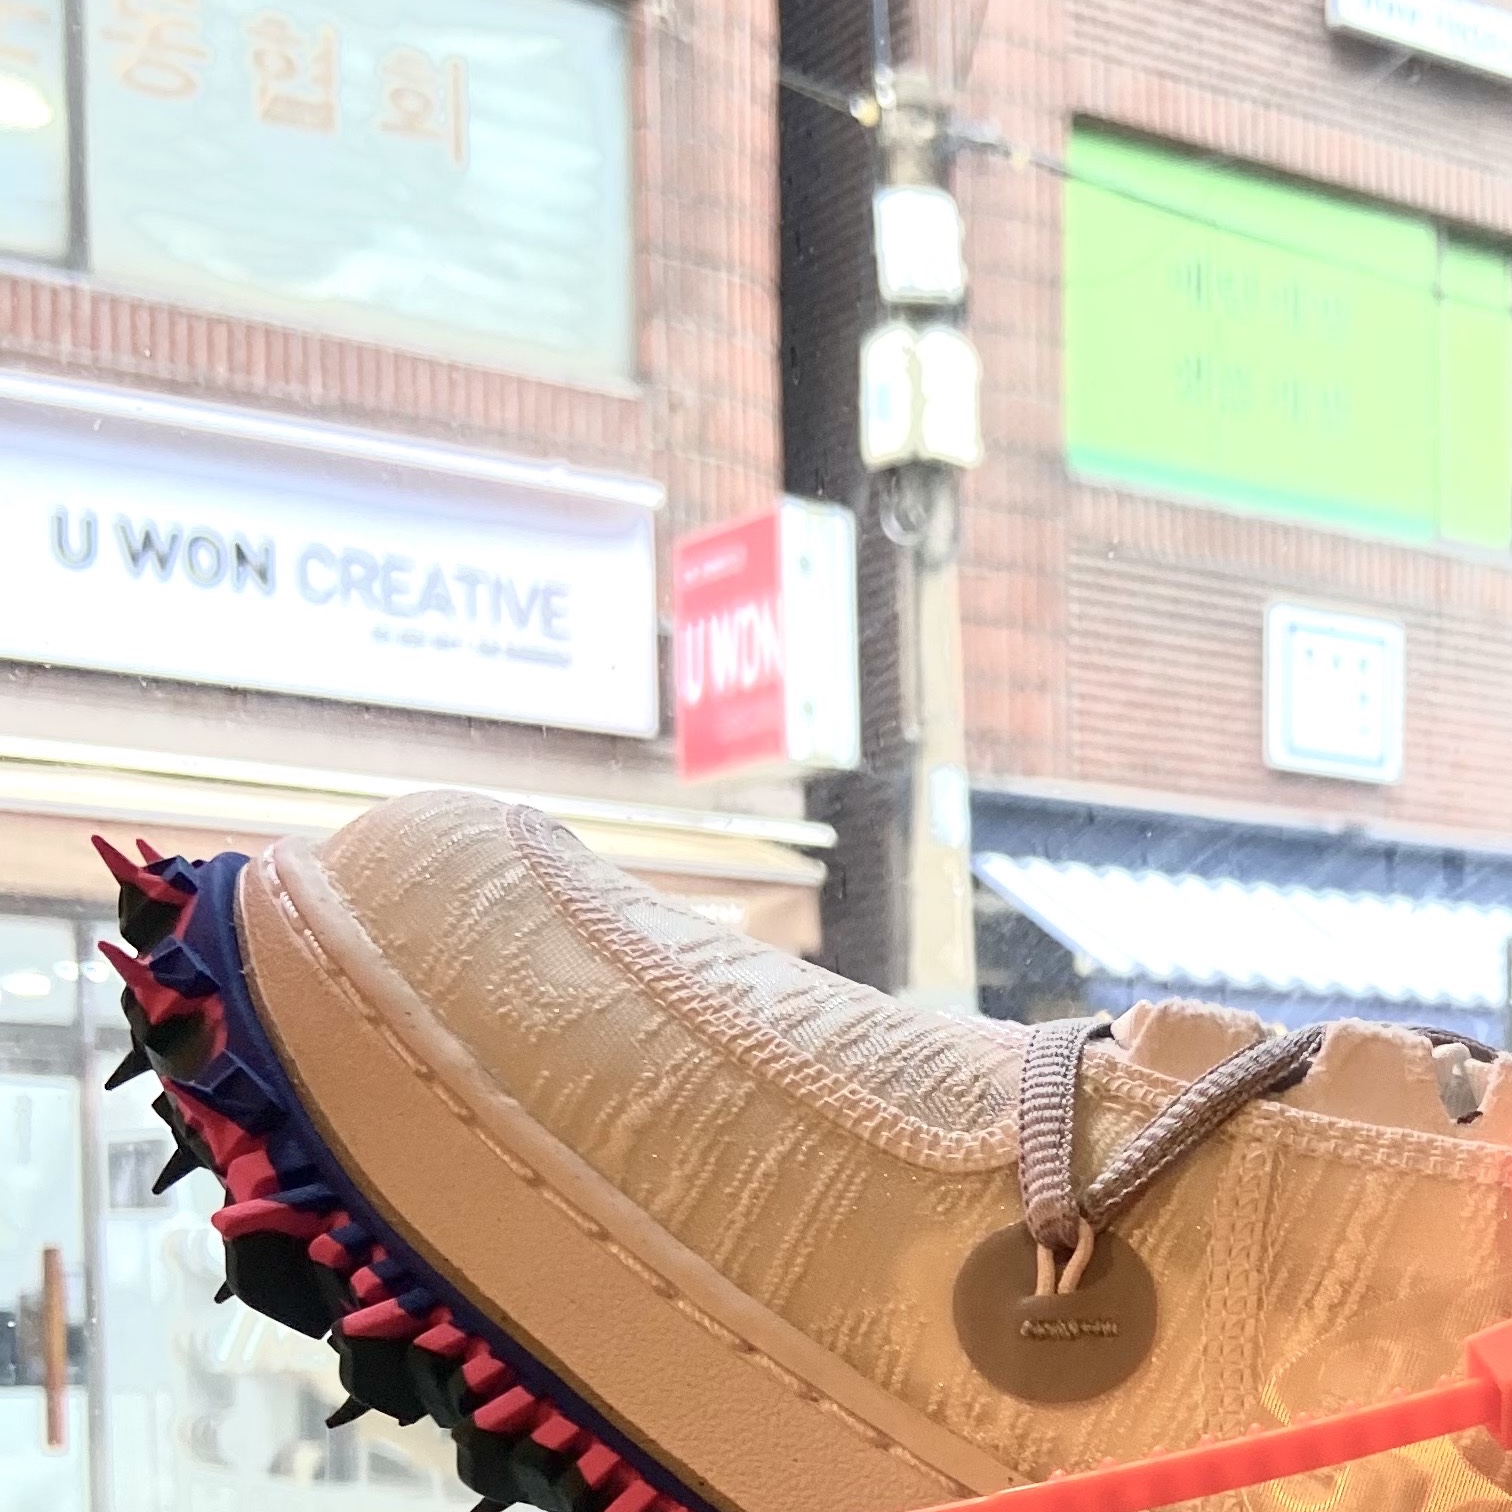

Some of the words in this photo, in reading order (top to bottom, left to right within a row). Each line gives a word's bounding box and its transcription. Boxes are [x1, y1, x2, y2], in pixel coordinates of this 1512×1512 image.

[54, 508, 96, 569] U
[117, 519, 275, 595] WON
[300, 542, 571, 641] CREATIVE
[682, 616, 705, 705] U
